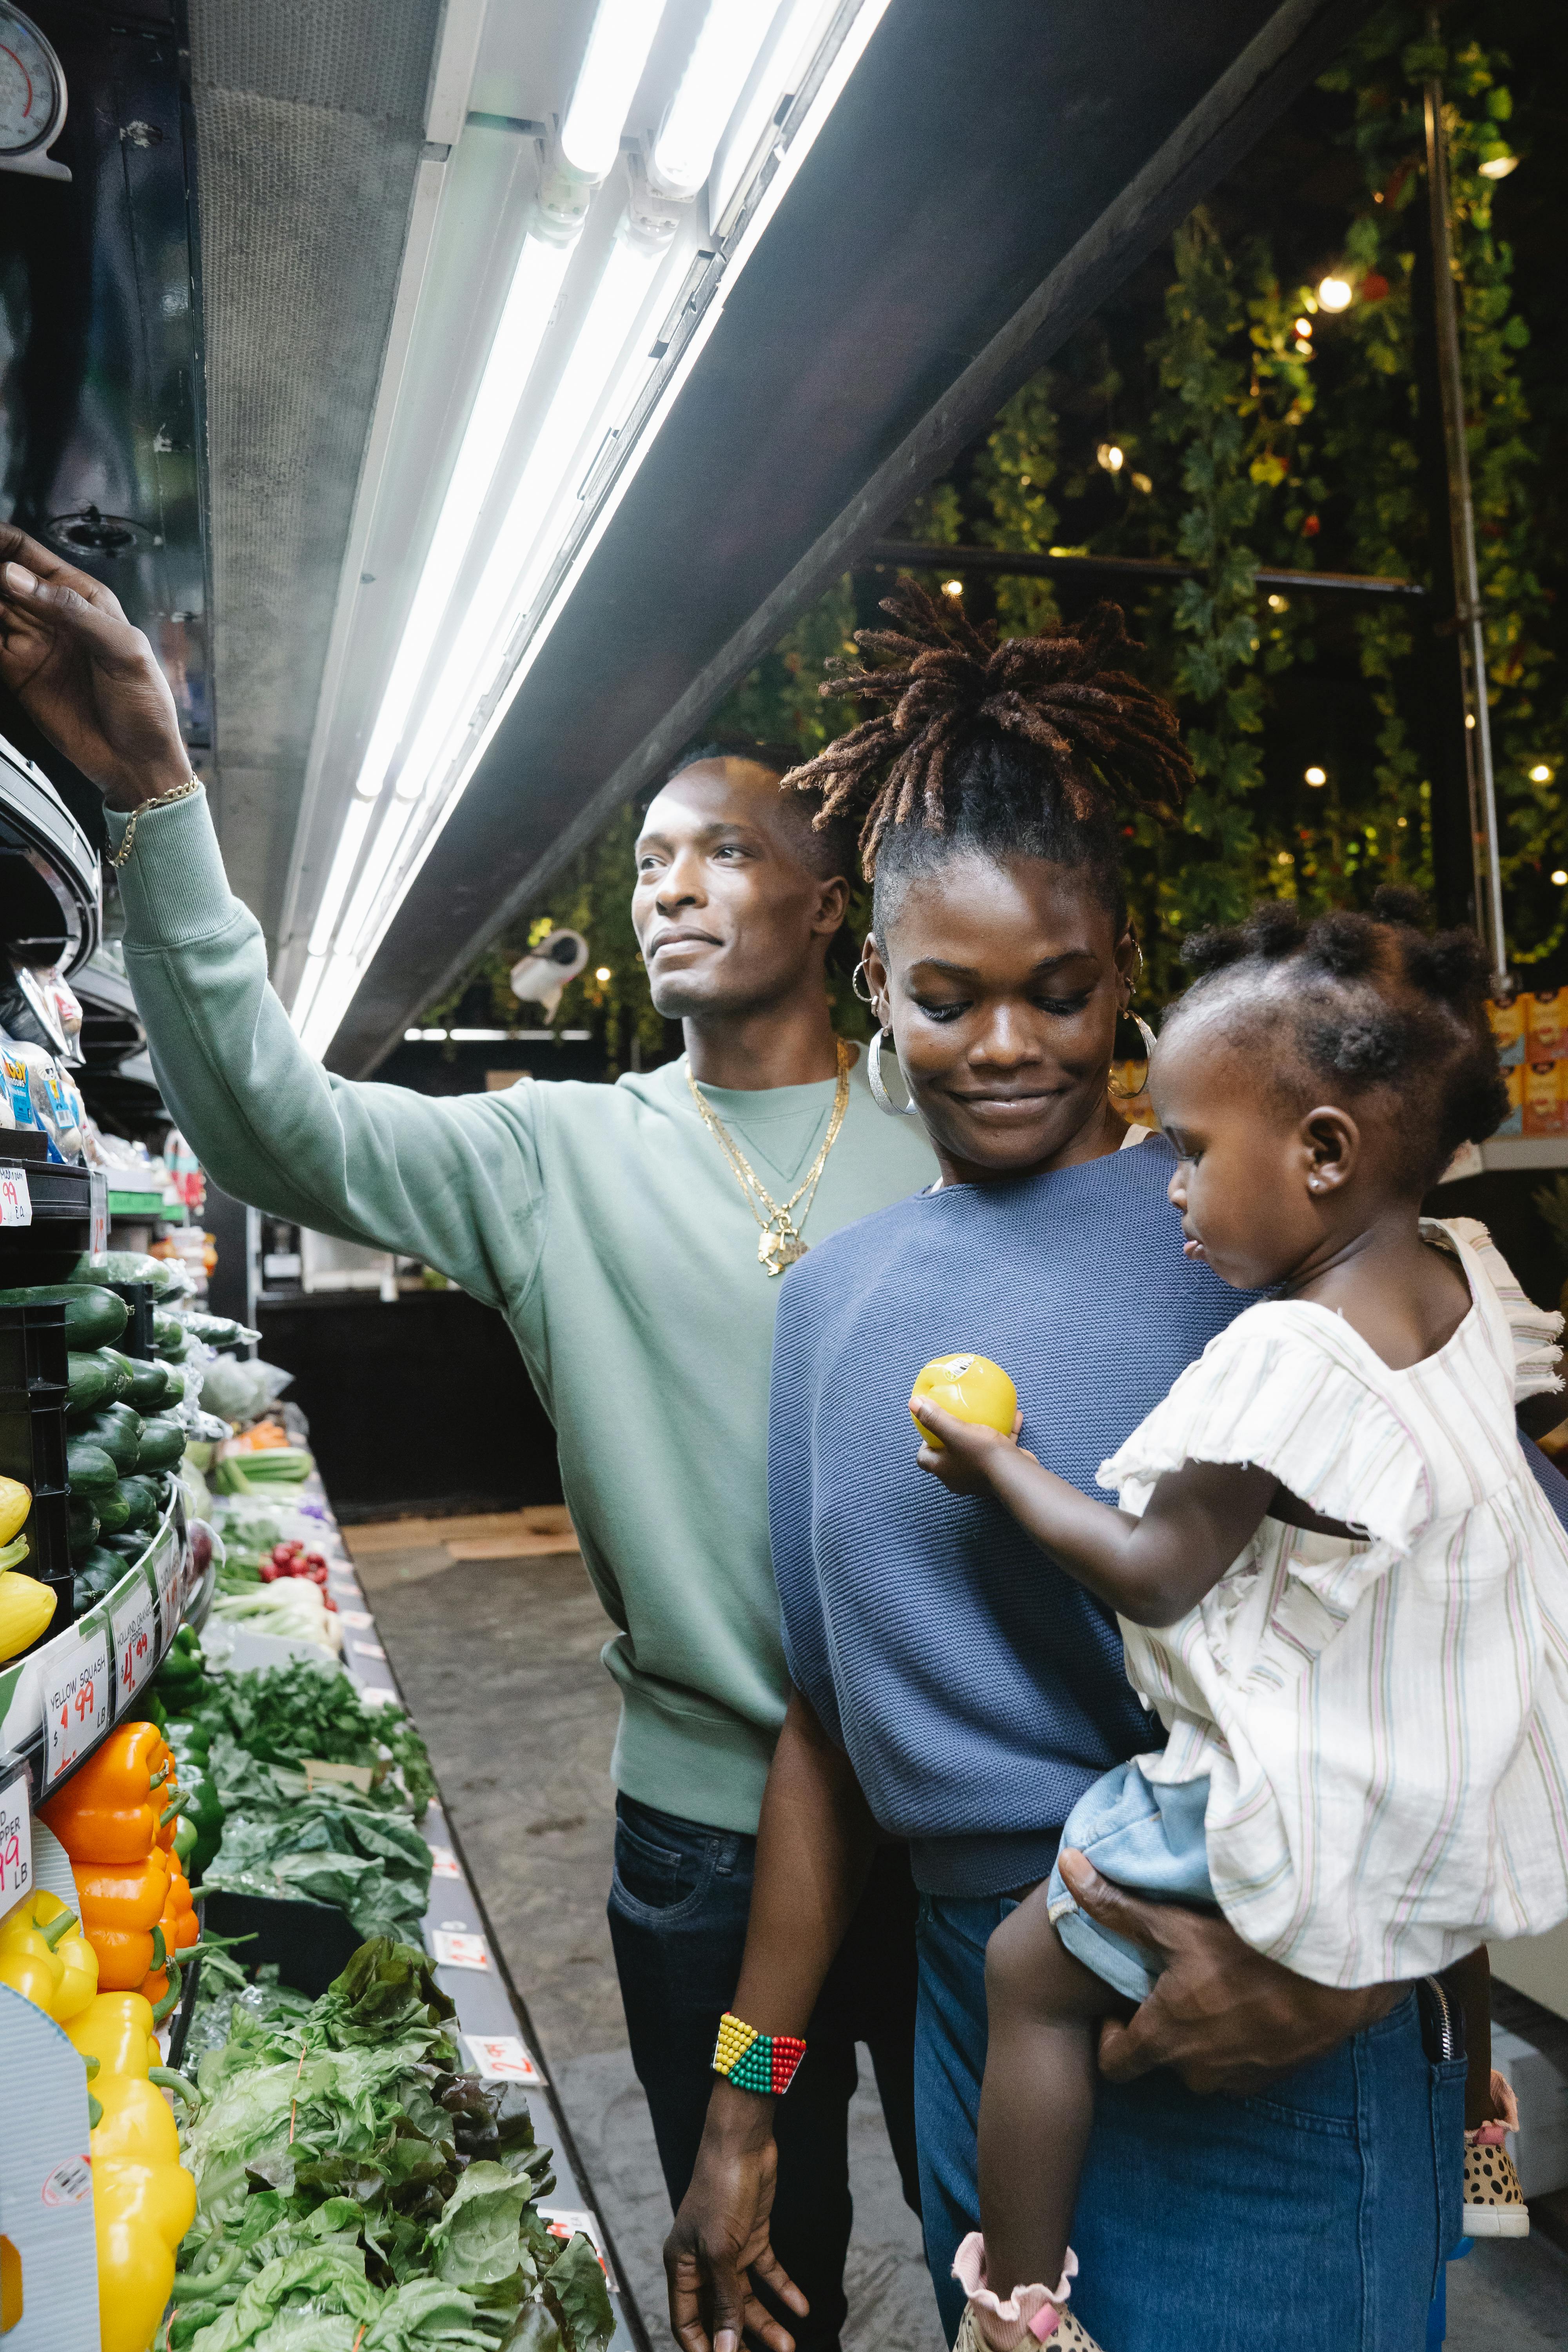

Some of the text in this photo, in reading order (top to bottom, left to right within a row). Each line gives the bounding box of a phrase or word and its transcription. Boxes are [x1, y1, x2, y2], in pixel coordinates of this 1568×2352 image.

[118, 1620, 136, 1650] HOLLAND
[51, 1654, 105, 1712] YELLOW SQUASH
[97, 1706, 105, 1729] LB
[15, 1862, 27, 1889] LB
